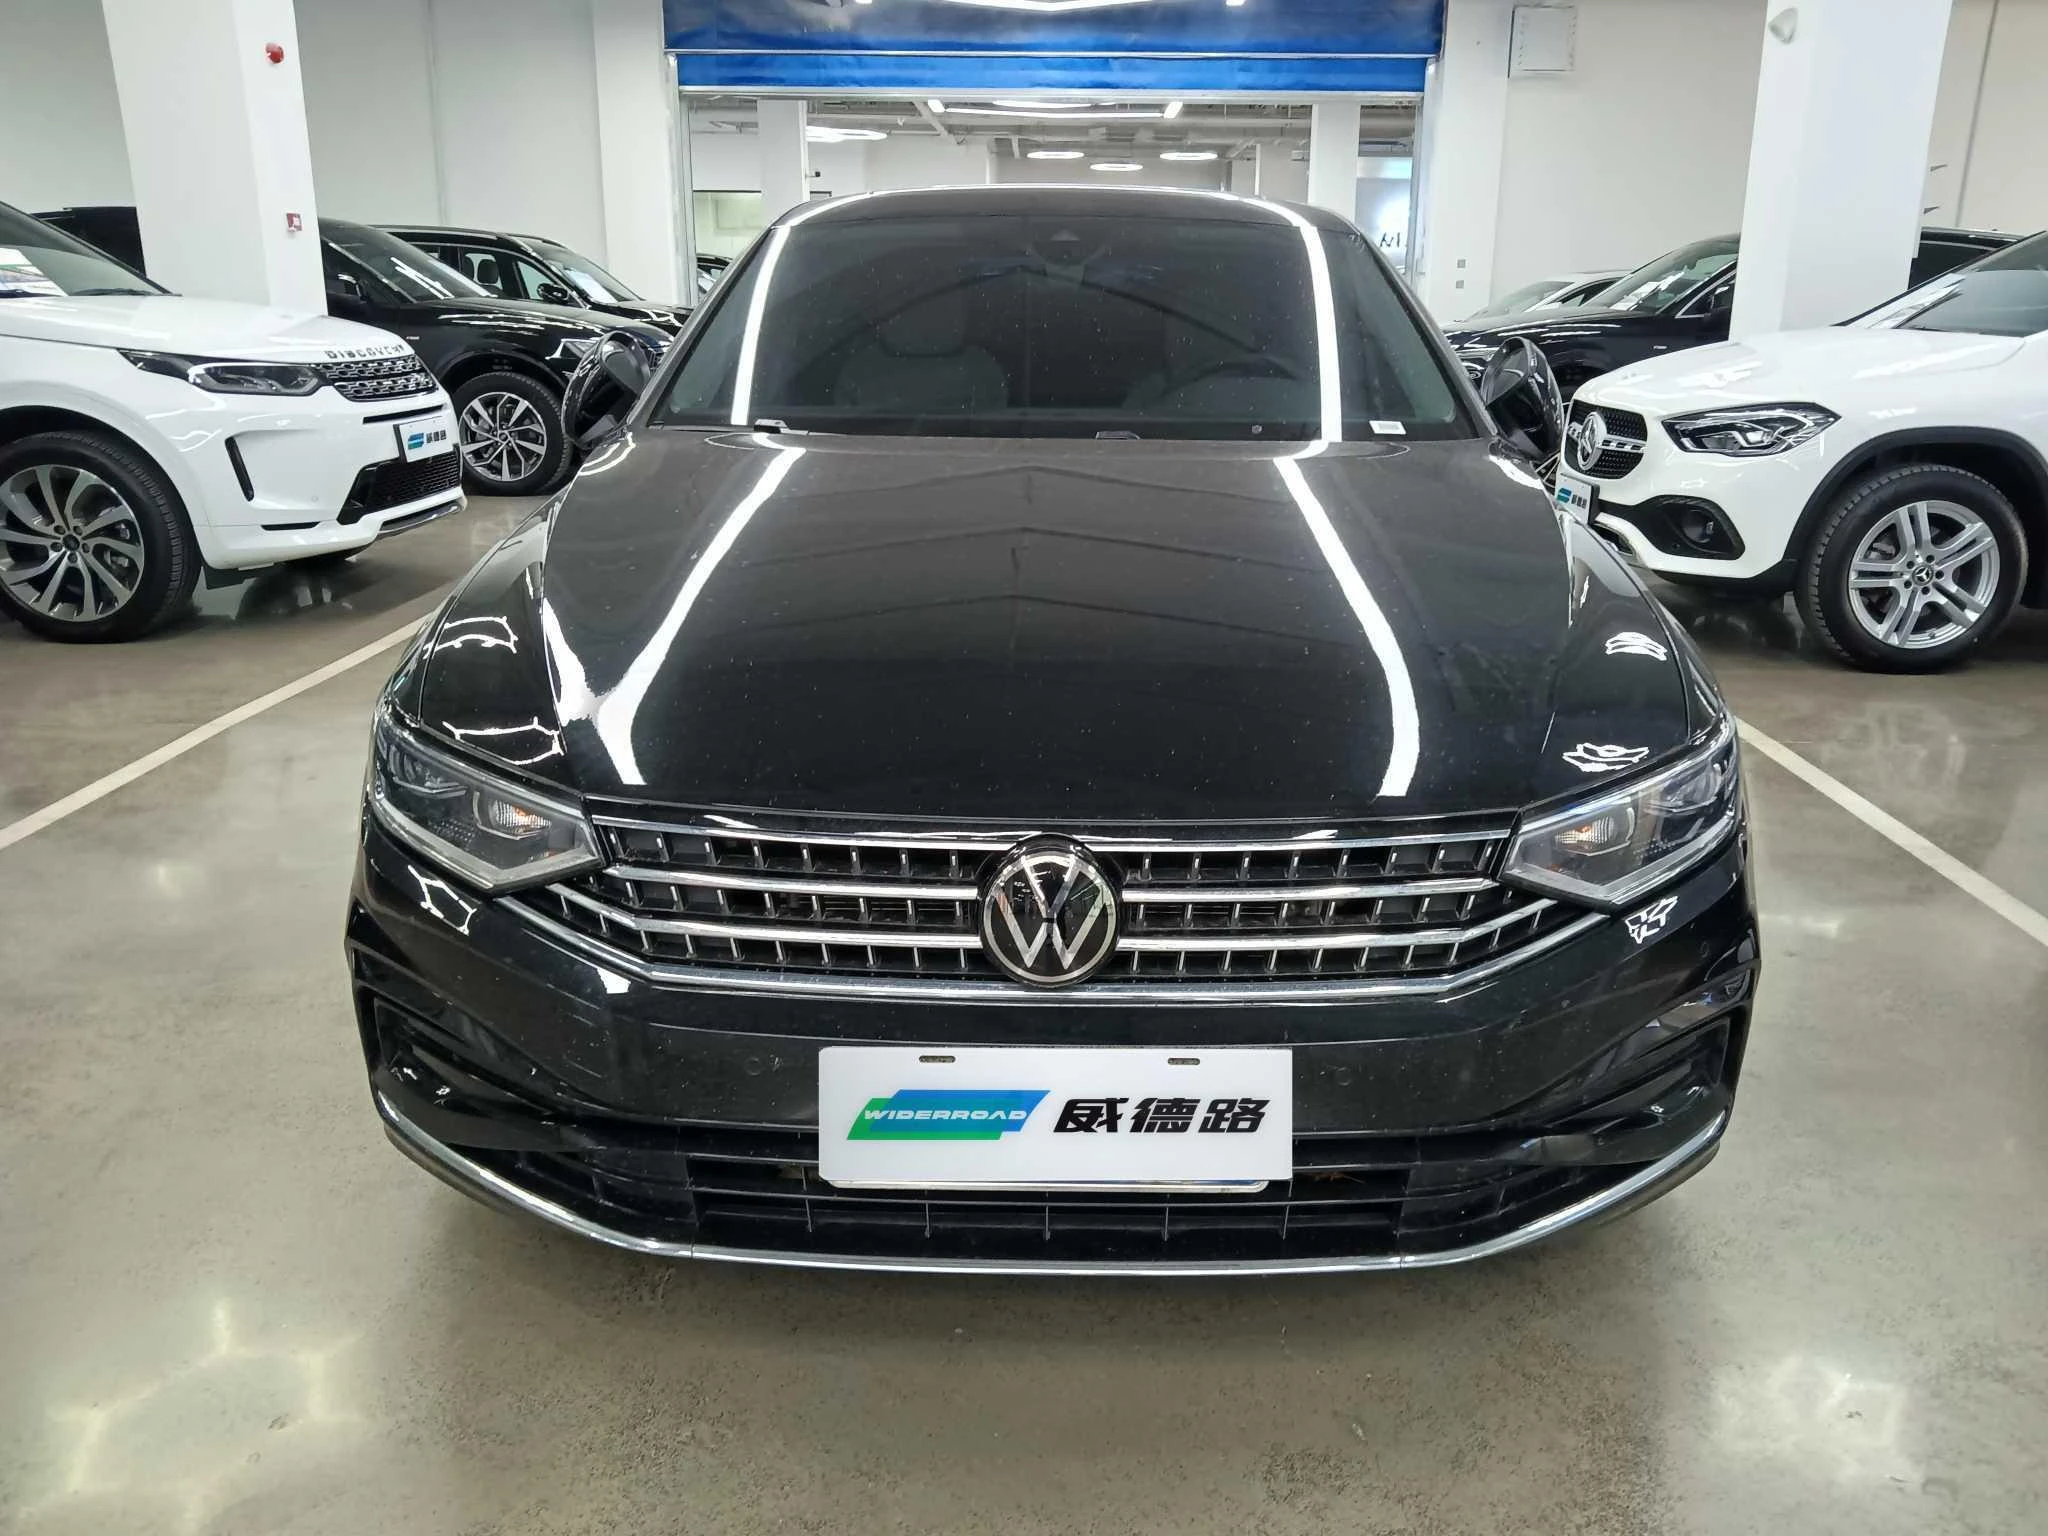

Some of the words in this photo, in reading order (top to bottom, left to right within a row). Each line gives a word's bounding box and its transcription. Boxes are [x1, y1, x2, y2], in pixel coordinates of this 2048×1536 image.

[864, 1110, 1027, 1120] WIDERROAD
[1053, 1098, 1269, 1133] 威德路
